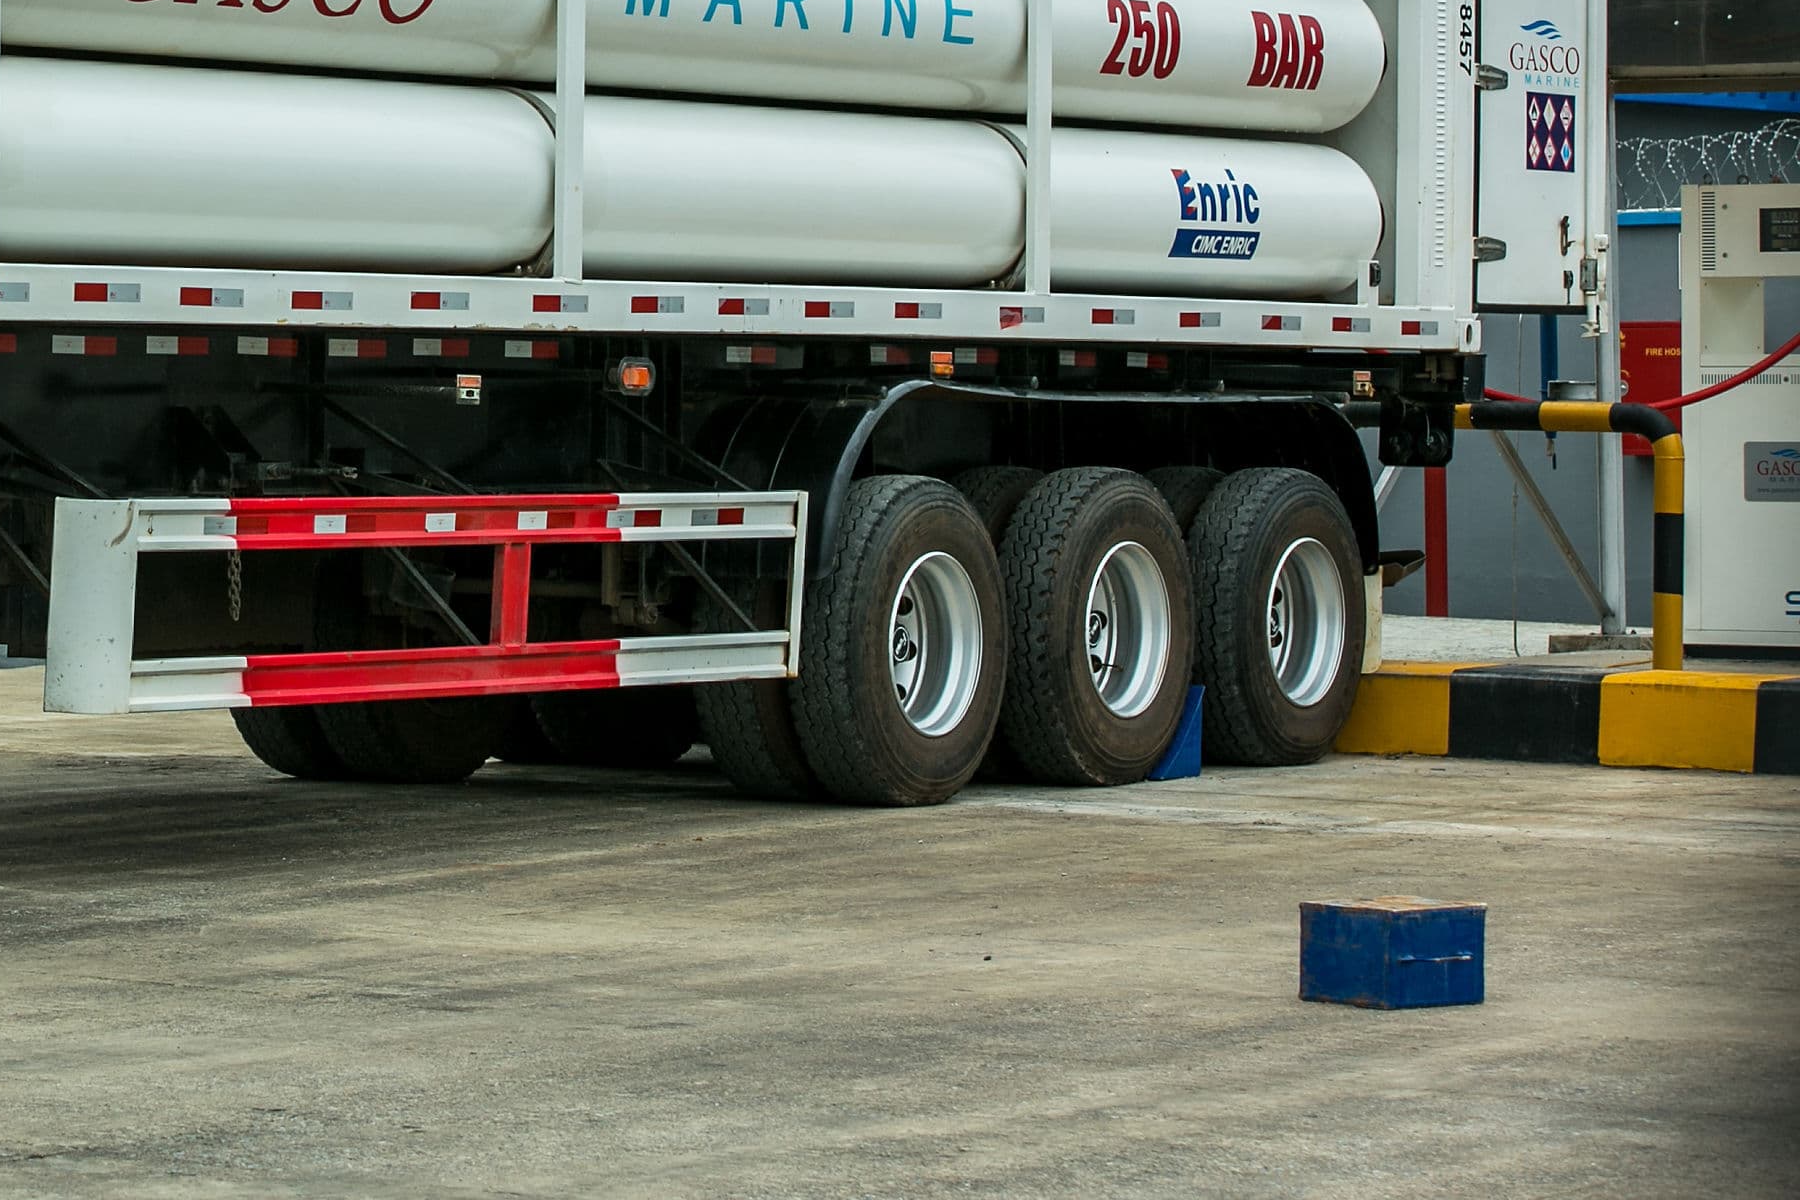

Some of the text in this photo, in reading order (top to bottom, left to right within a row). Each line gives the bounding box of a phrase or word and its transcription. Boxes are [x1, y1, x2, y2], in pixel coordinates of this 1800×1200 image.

[1246, 10, 1325, 91] BAR
[1509, 42, 1580, 75] GASCO
[1524, 73, 1581, 89] MARINE
[1170, 168, 1260, 225] Enric
[1191, 235, 1256, 256] CIMC ENRIC
[1645, 347, 1663, 356] FIRE
